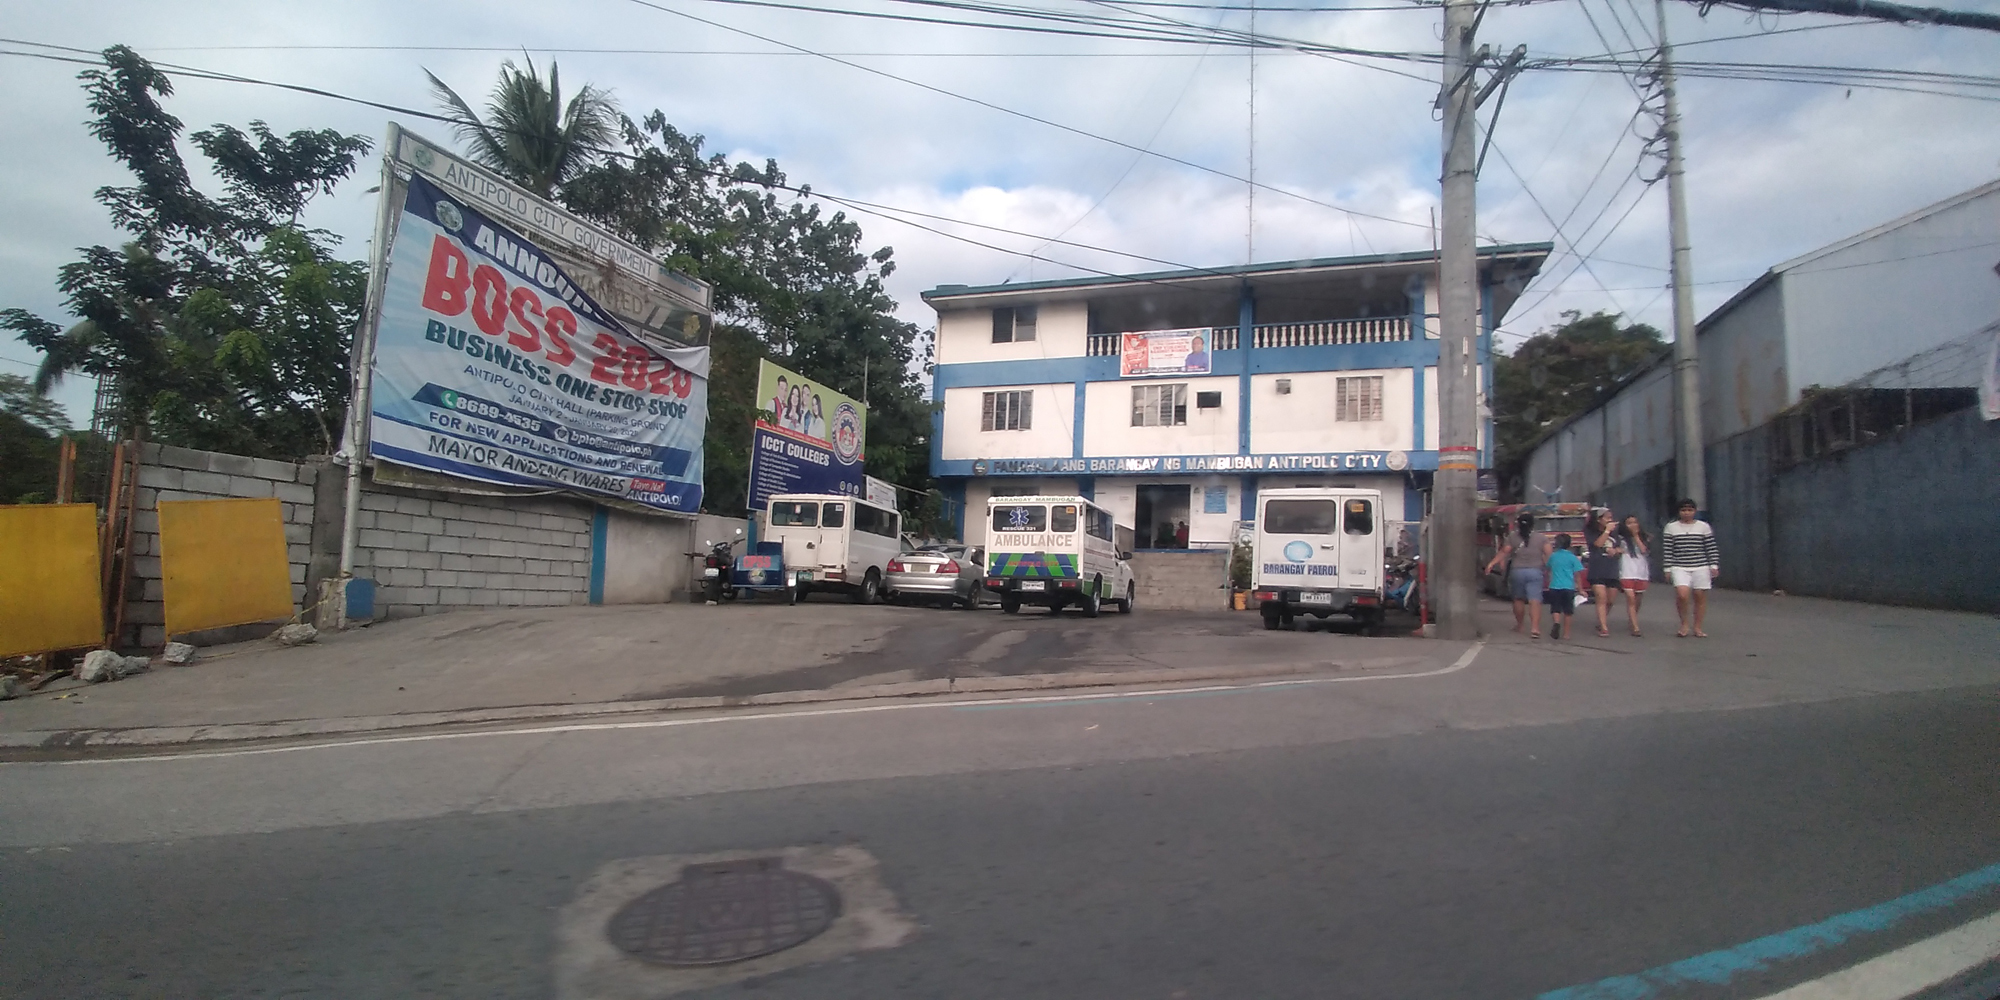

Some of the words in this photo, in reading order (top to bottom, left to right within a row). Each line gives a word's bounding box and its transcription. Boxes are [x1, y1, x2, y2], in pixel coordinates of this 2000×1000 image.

[445, 163, 528, 215] ANTIPOLO
[533, 206, 568, 235] CITY
[574, 226, 653, 277] GOVERNMENT
[422, 233, 578, 367] BOSS
[590, 332, 692, 399] 2020
[425, 318, 552, 386] BUSINESS
[555, 373, 599, 402] ONE
[599, 388, 646, 412] STOP
[647, 398, 688, 420] SHOP
[463, 364, 527, 395] ANTIPOLO
[529, 388, 554, 405] CITY
[556, 398, 584, 415] HALL
[586, 408, 629, 426] (PARKING
[456, 396, 542, 432] 8689-4535
[555, 410, 564, 418] 2
[429, 411, 461, 430] FOR
[465, 421, 500, 440] NEW
[501, 432, 593, 464] APPLICATIONS
[594, 456, 618, 470] AND
[571, 430, 652, 456] bplo@antipolo.ph
[761, 435, 786, 454] ICCT
[787, 442, 831, 467] COLLEGES
[428, 434, 499, 466] MAYOR
[501, 454, 569, 481] ANDENG
[573, 469, 625, 494] YNARES
[1090, 457, 1160, 471] BARANGAY
[1163, 457, 1182, 470] NG
[1186, 455, 1263, 470] MAMBUGAN
[1345, 453, 1382, 468] CITY
[633, 479, 651, 490] Tayo
[994, 534, 1073, 547] AMBULANCE
[743, 555, 771, 568] OPSS
[1263, 563, 1306, 575] BARANGAY
[1308, 564, 1338, 576] PATROL
